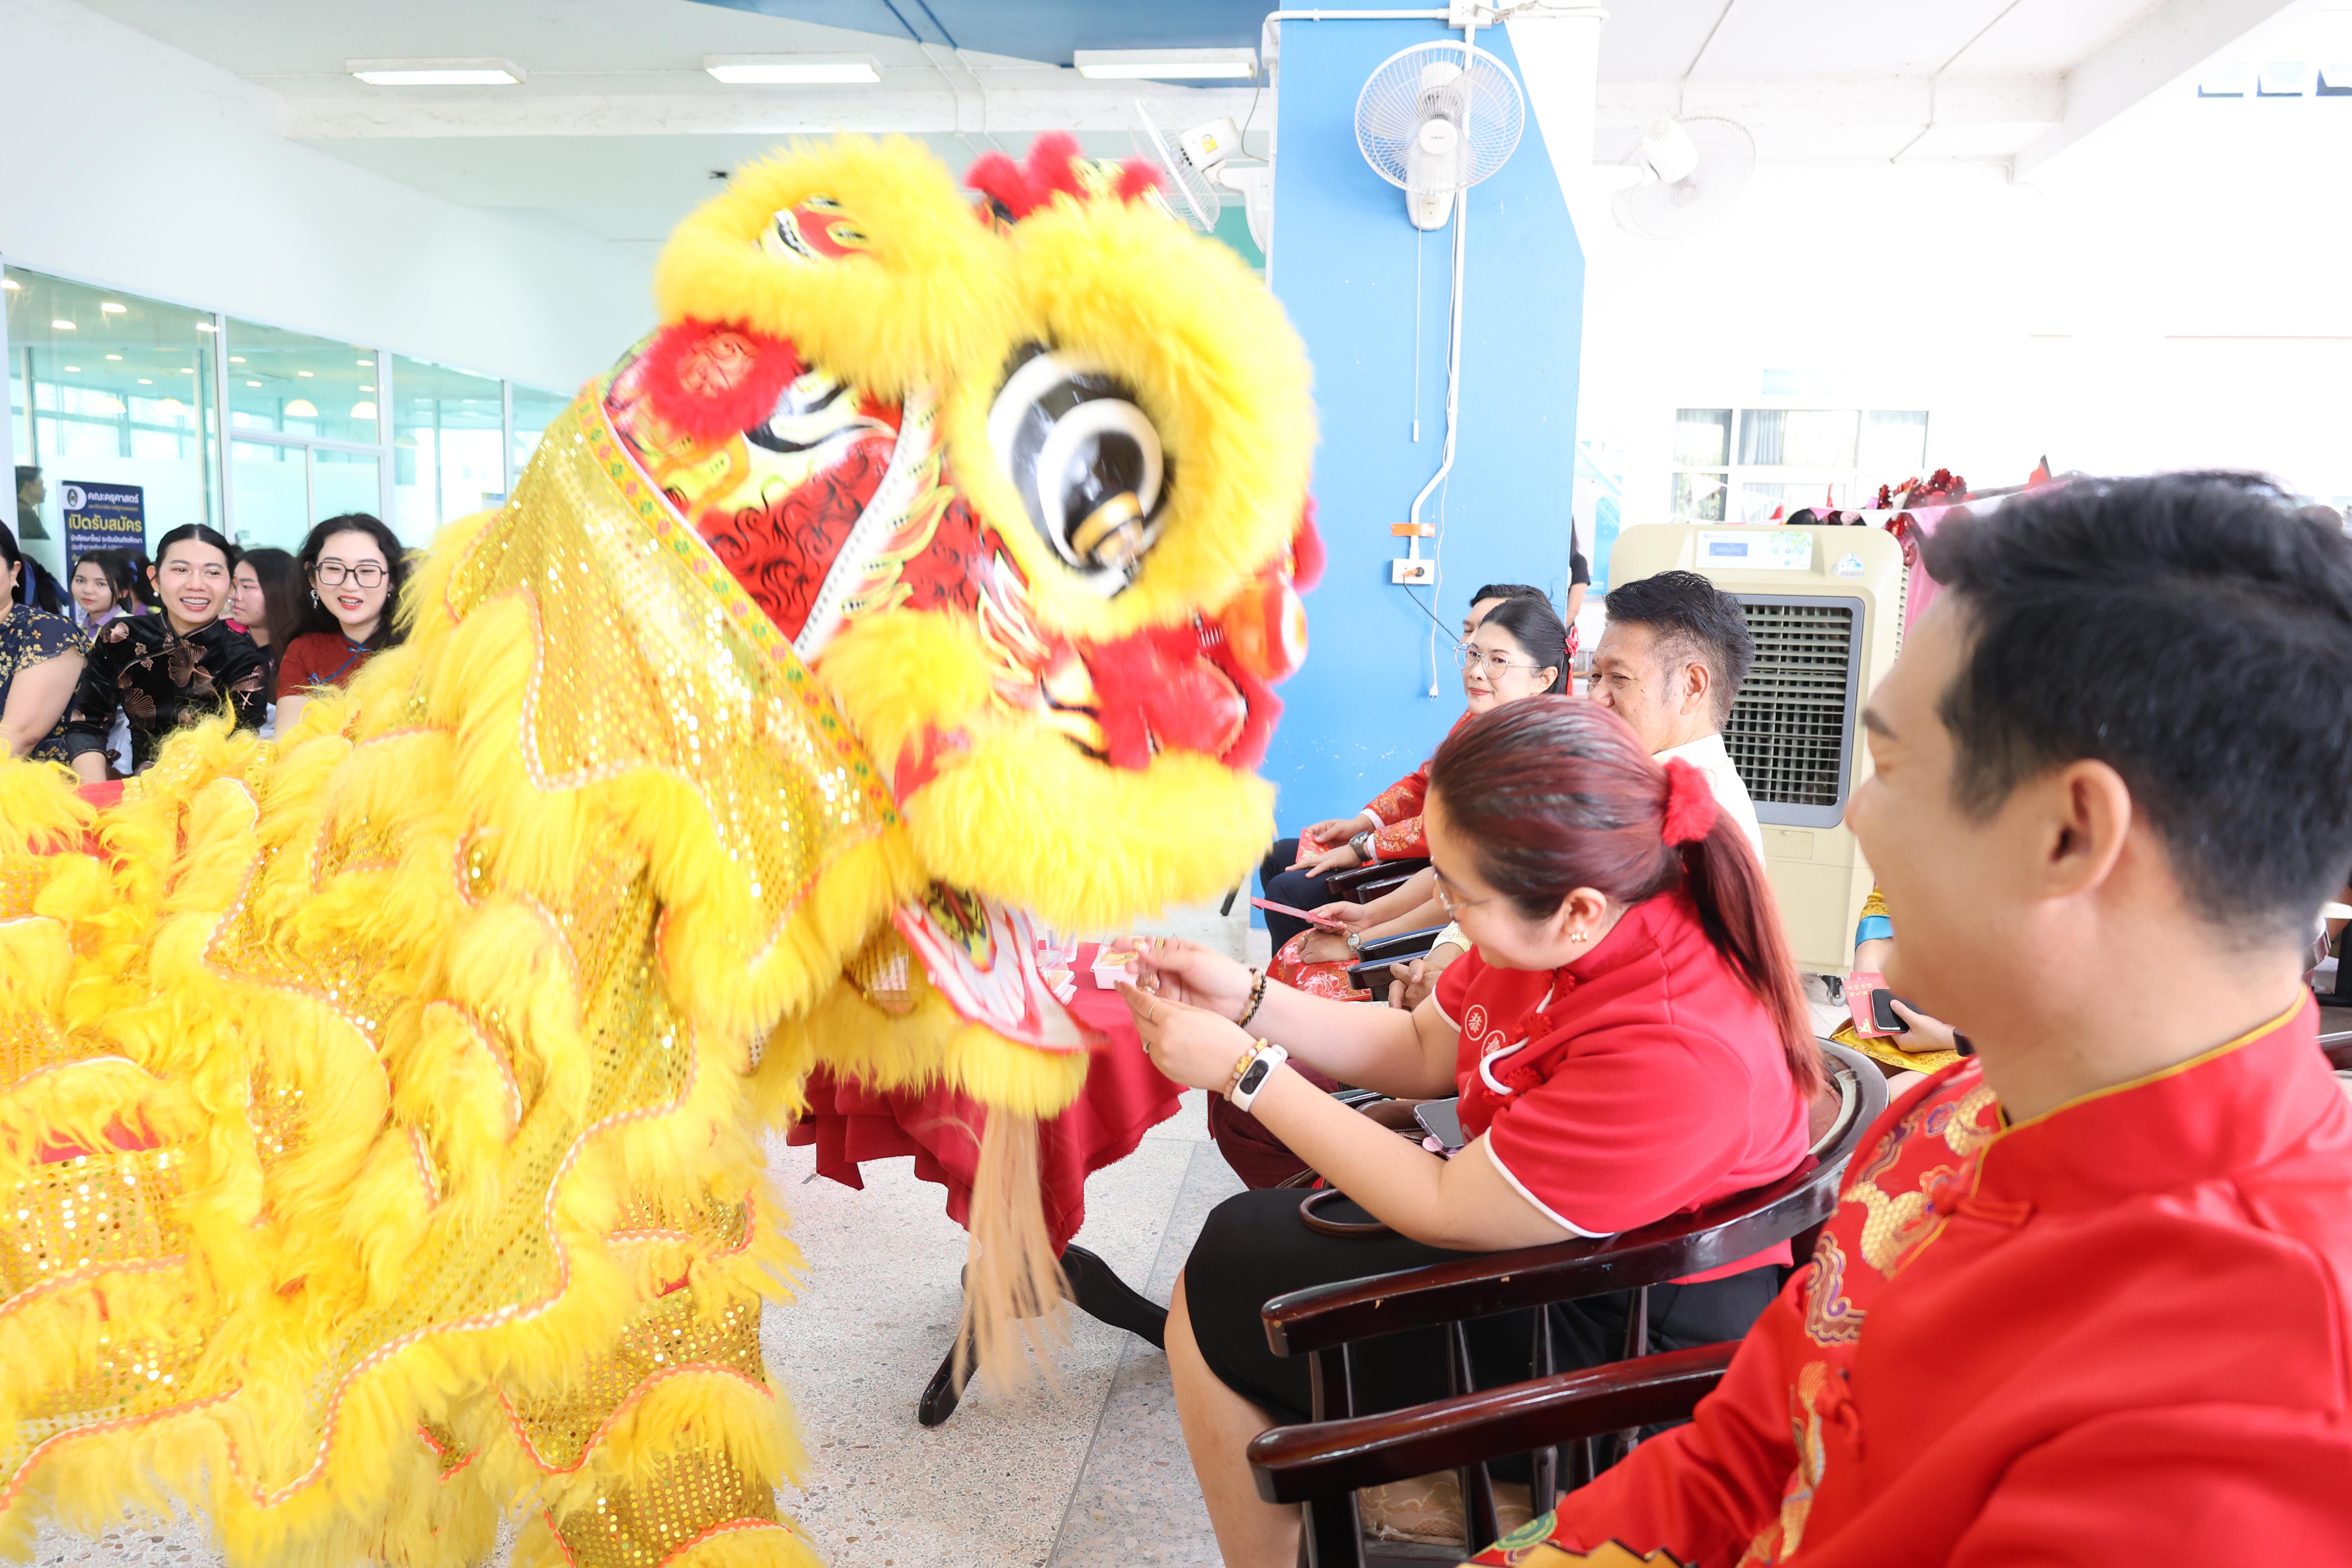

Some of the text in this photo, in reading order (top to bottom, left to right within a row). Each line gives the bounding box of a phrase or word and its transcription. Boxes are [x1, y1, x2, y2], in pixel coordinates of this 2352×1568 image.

[88, 492, 139, 504] คณะครุศาสตร์
[69, 514, 142, 532] เปิดรับสมัคร
